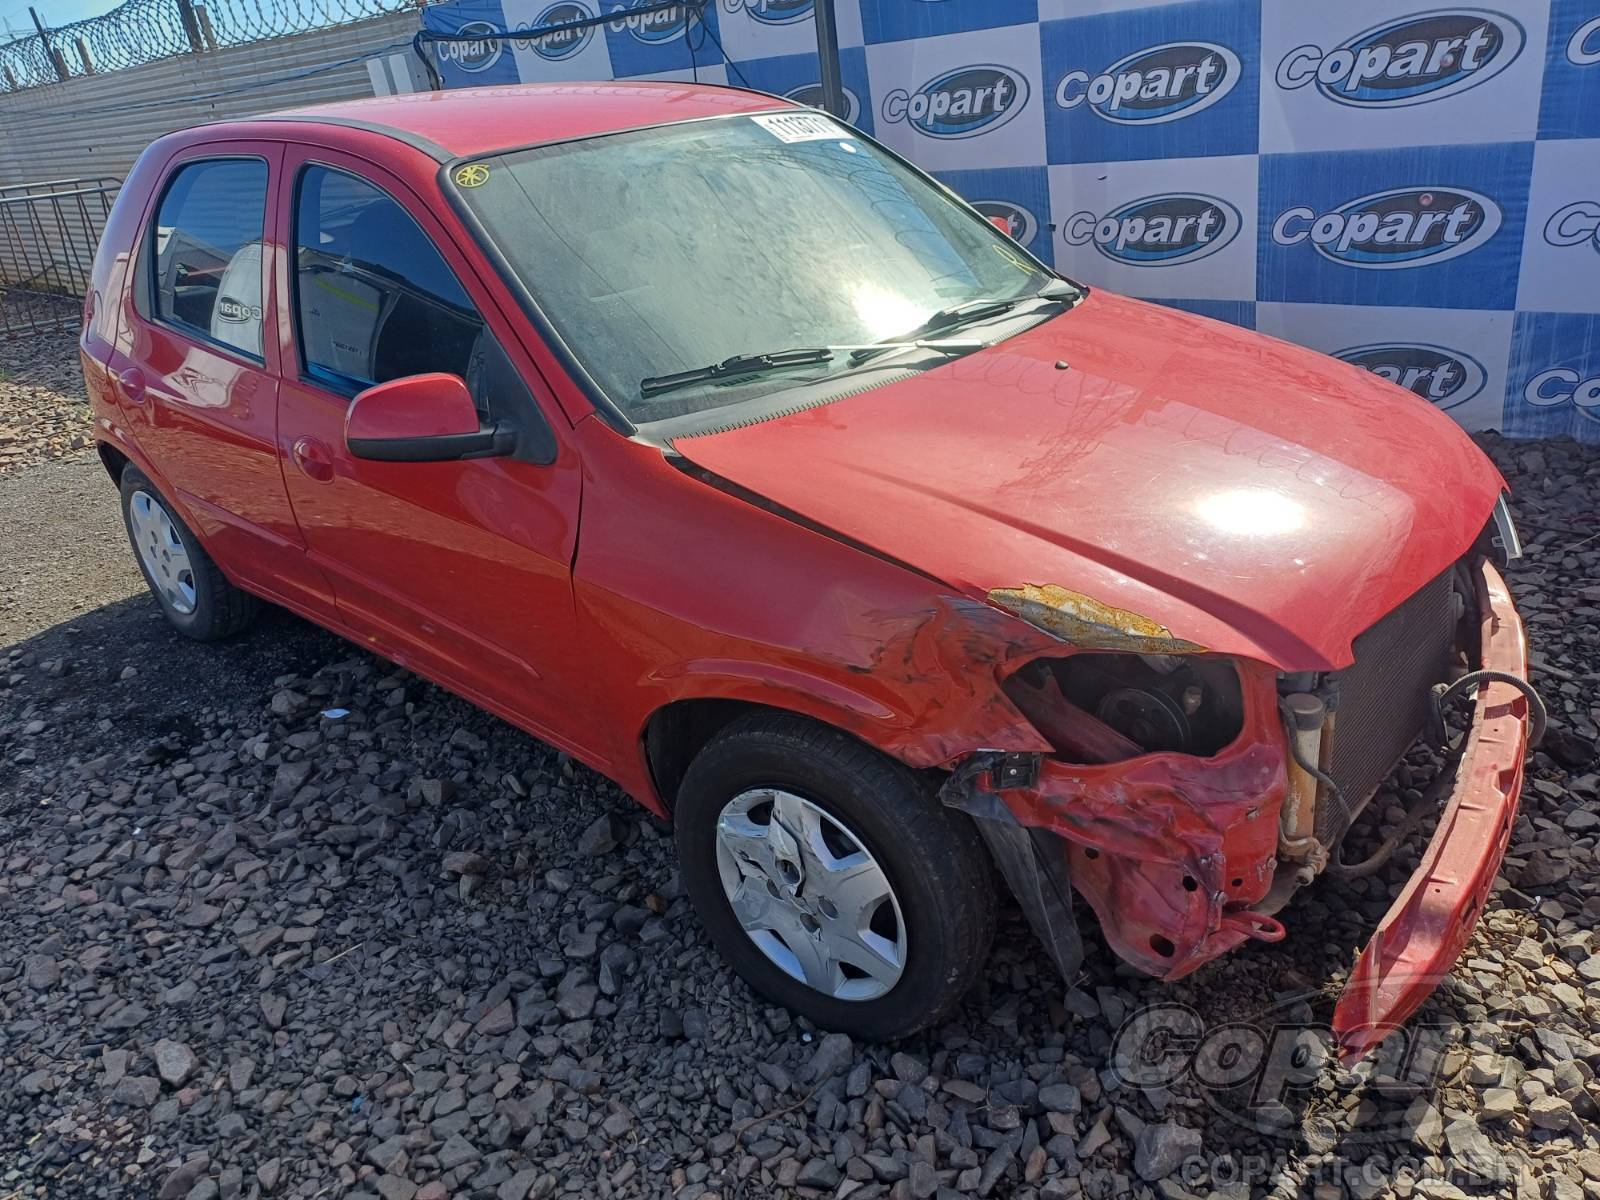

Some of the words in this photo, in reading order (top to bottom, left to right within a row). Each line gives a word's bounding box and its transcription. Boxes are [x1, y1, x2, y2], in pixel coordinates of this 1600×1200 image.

[437, 29, 496, 63] Copart
[1276, 22, 1491, 92] Copart
[882, 75, 1010, 126] Copart
[1056, 53, 1217, 111] Copart
[1063, 206, 1218, 251] Copart
[1272, 199, 1473, 252] Copart
